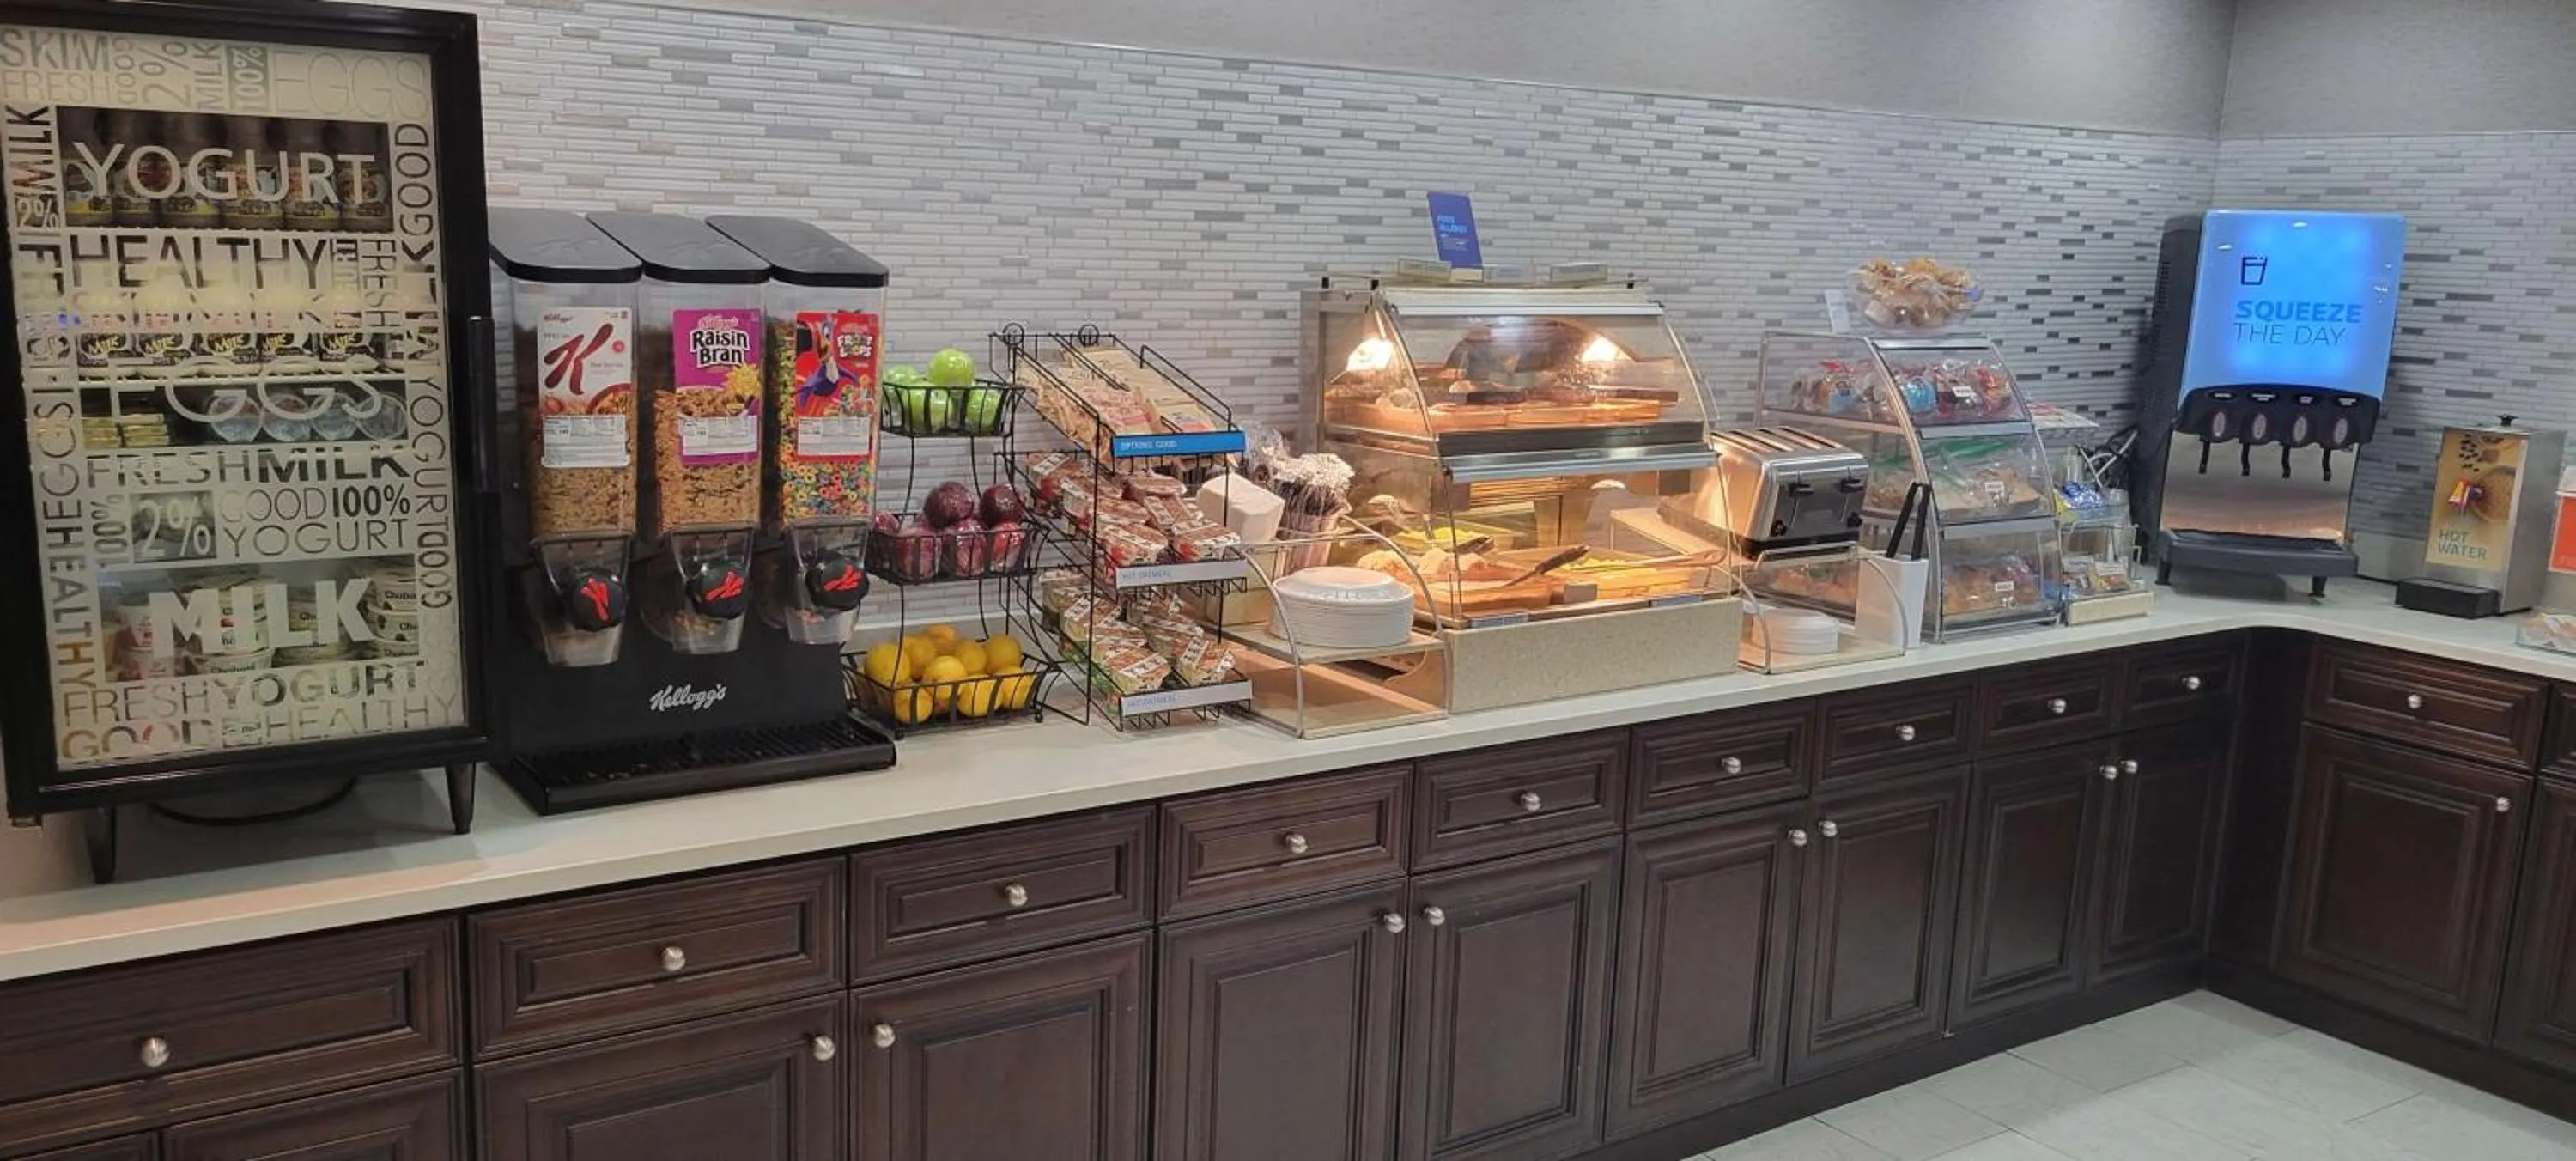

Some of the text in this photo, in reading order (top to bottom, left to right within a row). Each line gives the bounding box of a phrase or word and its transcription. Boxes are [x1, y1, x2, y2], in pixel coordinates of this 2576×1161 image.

[0, 27, 110, 71] SKIM
[191, 42, 223, 111] MILK
[232, 46, 267, 112] 100%
[3, 68, 111, 103] FRESH
[274, 50, 428, 119] EGGS
[4, 104, 57, 193] MILK
[74, 142, 376, 206] YOGURT
[395, 123, 434, 236] GOOD
[70, 234, 328, 290] HEALTHY
[361, 239, 400, 328] FRESH
[18, 244, 76, 393] FRSH
[690, 329, 749, 350] Raisin
[2233, 323, 2347, 346] THE DAY
[2234, 301, 2363, 323] SQUEEZE
[111, 355, 382, 422] EGGS
[544, 323, 614, 396] K
[699, 348, 743, 365] Bran
[33, 401, 83, 519] EGGS
[86, 445, 411, 488] FRESH MILK
[410, 372, 449, 532] YOGURT
[137, 496, 212, 557] 2%
[221, 483, 411, 522] GOOD 100%
[222, 518, 409, 557] YOGURT
[2438, 542, 2488, 560] WATER
[2439, 529, 2469, 543] HOT
[417, 530, 453, 609] GOOD
[46, 526, 96, 689] HEALTHY
[149, 578, 375, 660] MILK
[64, 660, 425, 726] FRESH YOGURT
[266, 688, 457, 743] HEALTHY
[649, 684, 727, 712] Kellogg's
